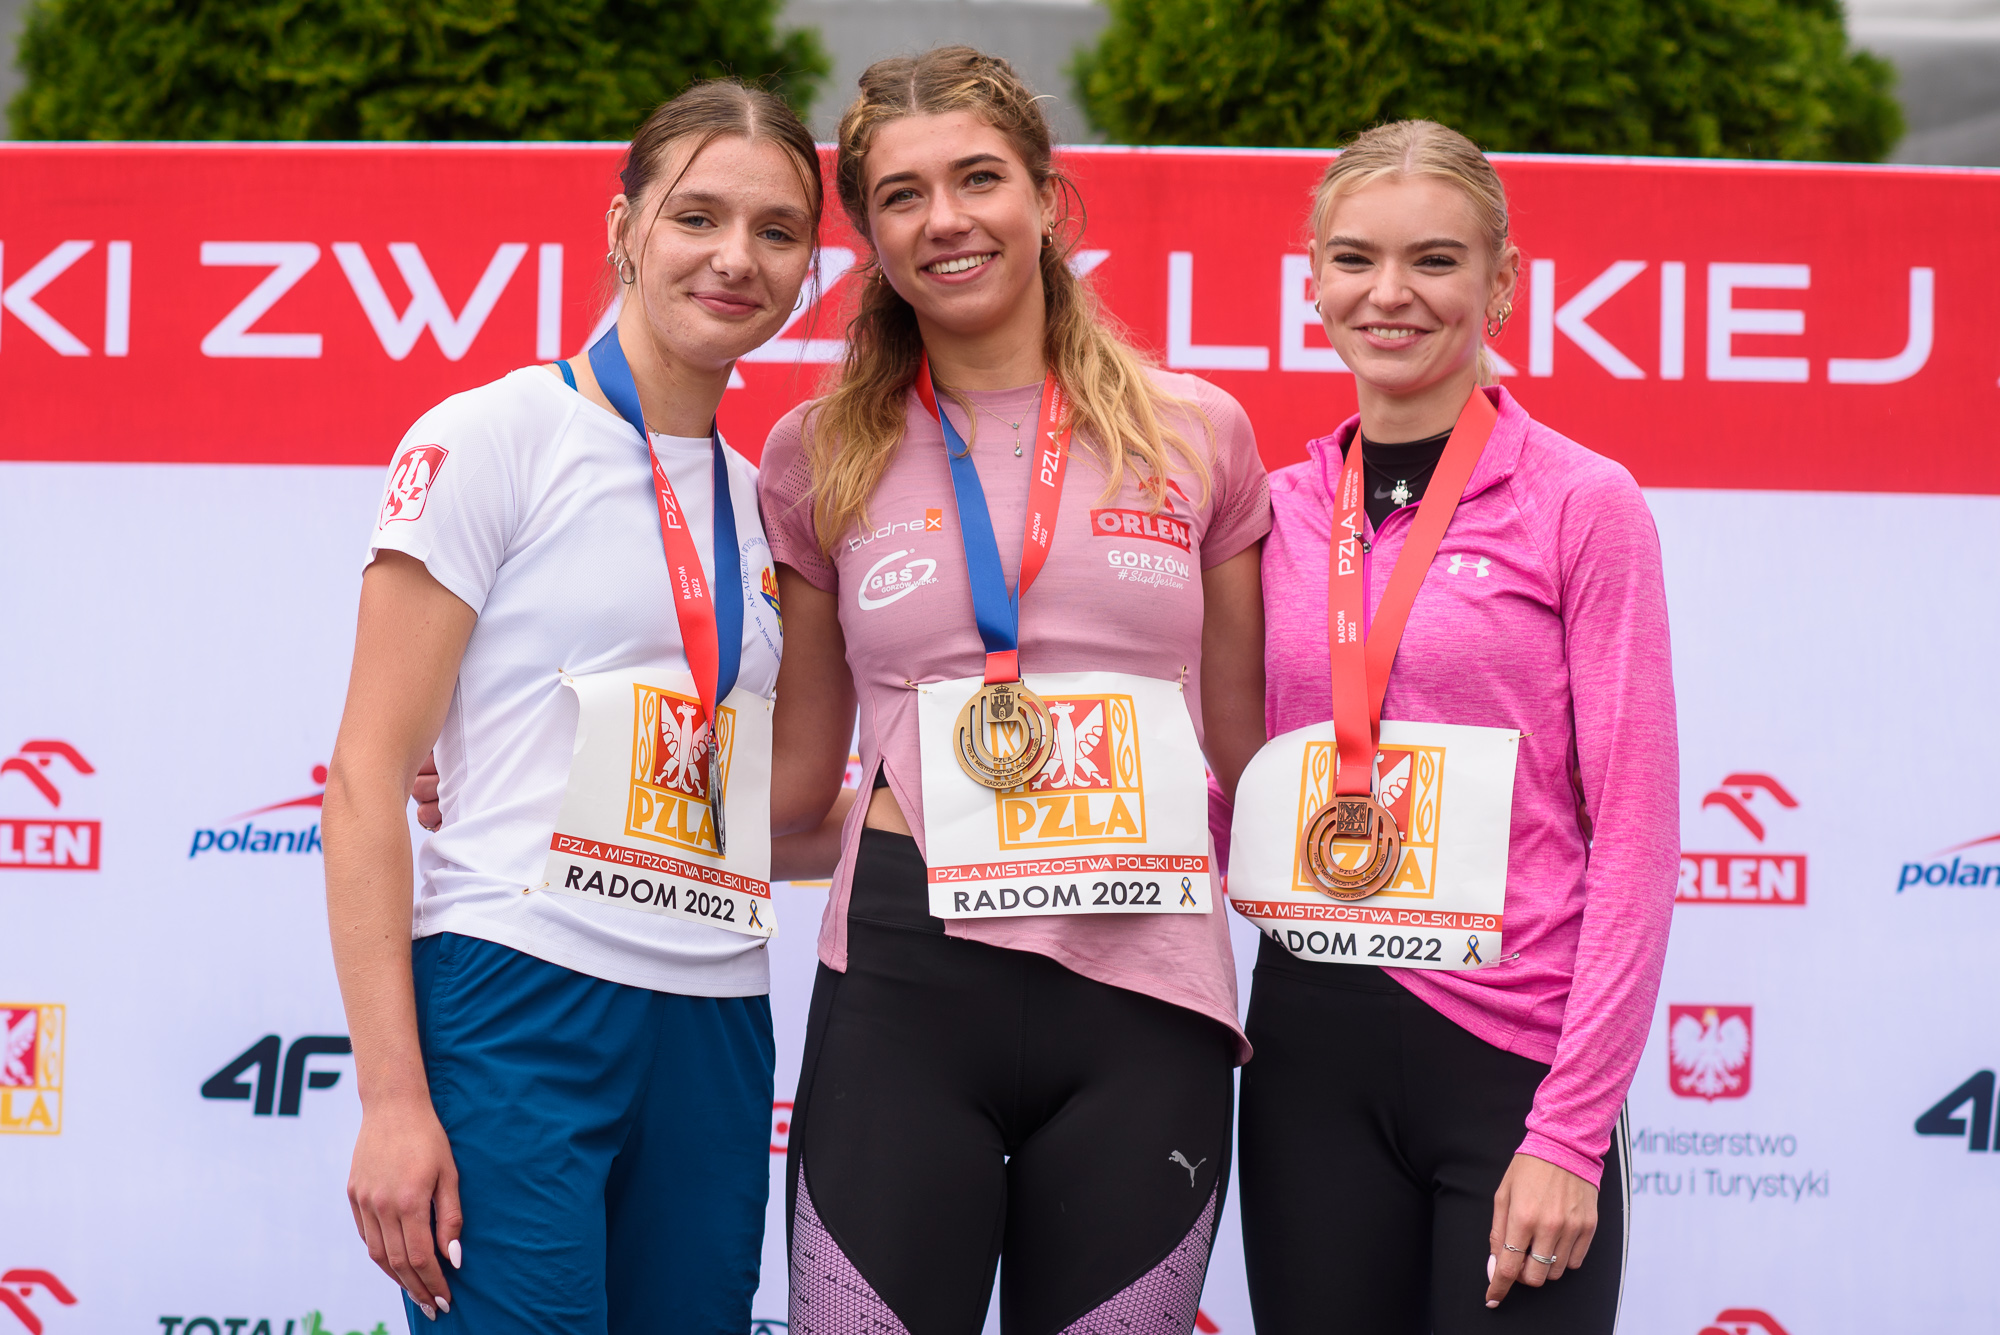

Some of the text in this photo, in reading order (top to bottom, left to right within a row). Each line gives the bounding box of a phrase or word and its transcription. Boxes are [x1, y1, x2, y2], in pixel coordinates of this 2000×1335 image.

[1167, 251, 1935, 384] LEKIEJ
[848, 517, 942, 552] budnex
[1032, 512, 1042, 542] RADOM
[1039, 528, 1048, 549] 2022
[1097, 511, 1188, 547] ORLEN
[1338, 511, 1357, 576] PZLA
[870, 568, 913, 589] GBS
[1107, 549, 1189, 578] GORZÓW
[677, 566, 692, 600] RADOM
[691, 577, 703, 599] 2022
[1337, 610, 1346, 644] RADOM
[1348, 621, 1357, 642] 2022
[633, 786, 719, 850] PZLA
[1004, 794, 1139, 841] PZLA
[1338, 822, 1363, 832] PZLA
[0, 823, 91, 866] LEN
[558, 836, 767, 896] PZLA MISTRZOSTWA POLSKI U20
[935, 857, 1203, 881] PZLA MISTRZOSTWA POLSKI U20
[1675, 858, 1797, 900] RLEN
[564, 865, 735, 922] RADOM 2022
[953, 881, 1162, 912] RADOM 2022
[1236, 902, 1496, 930] PZLA MISTRZOSTWA POLSKI U20
[1271, 928, 1442, 962] ADOM 2022
[200, 1035, 354, 1117] 4F
[1632, 1167, 1830, 1203] ortu i Turystyki
